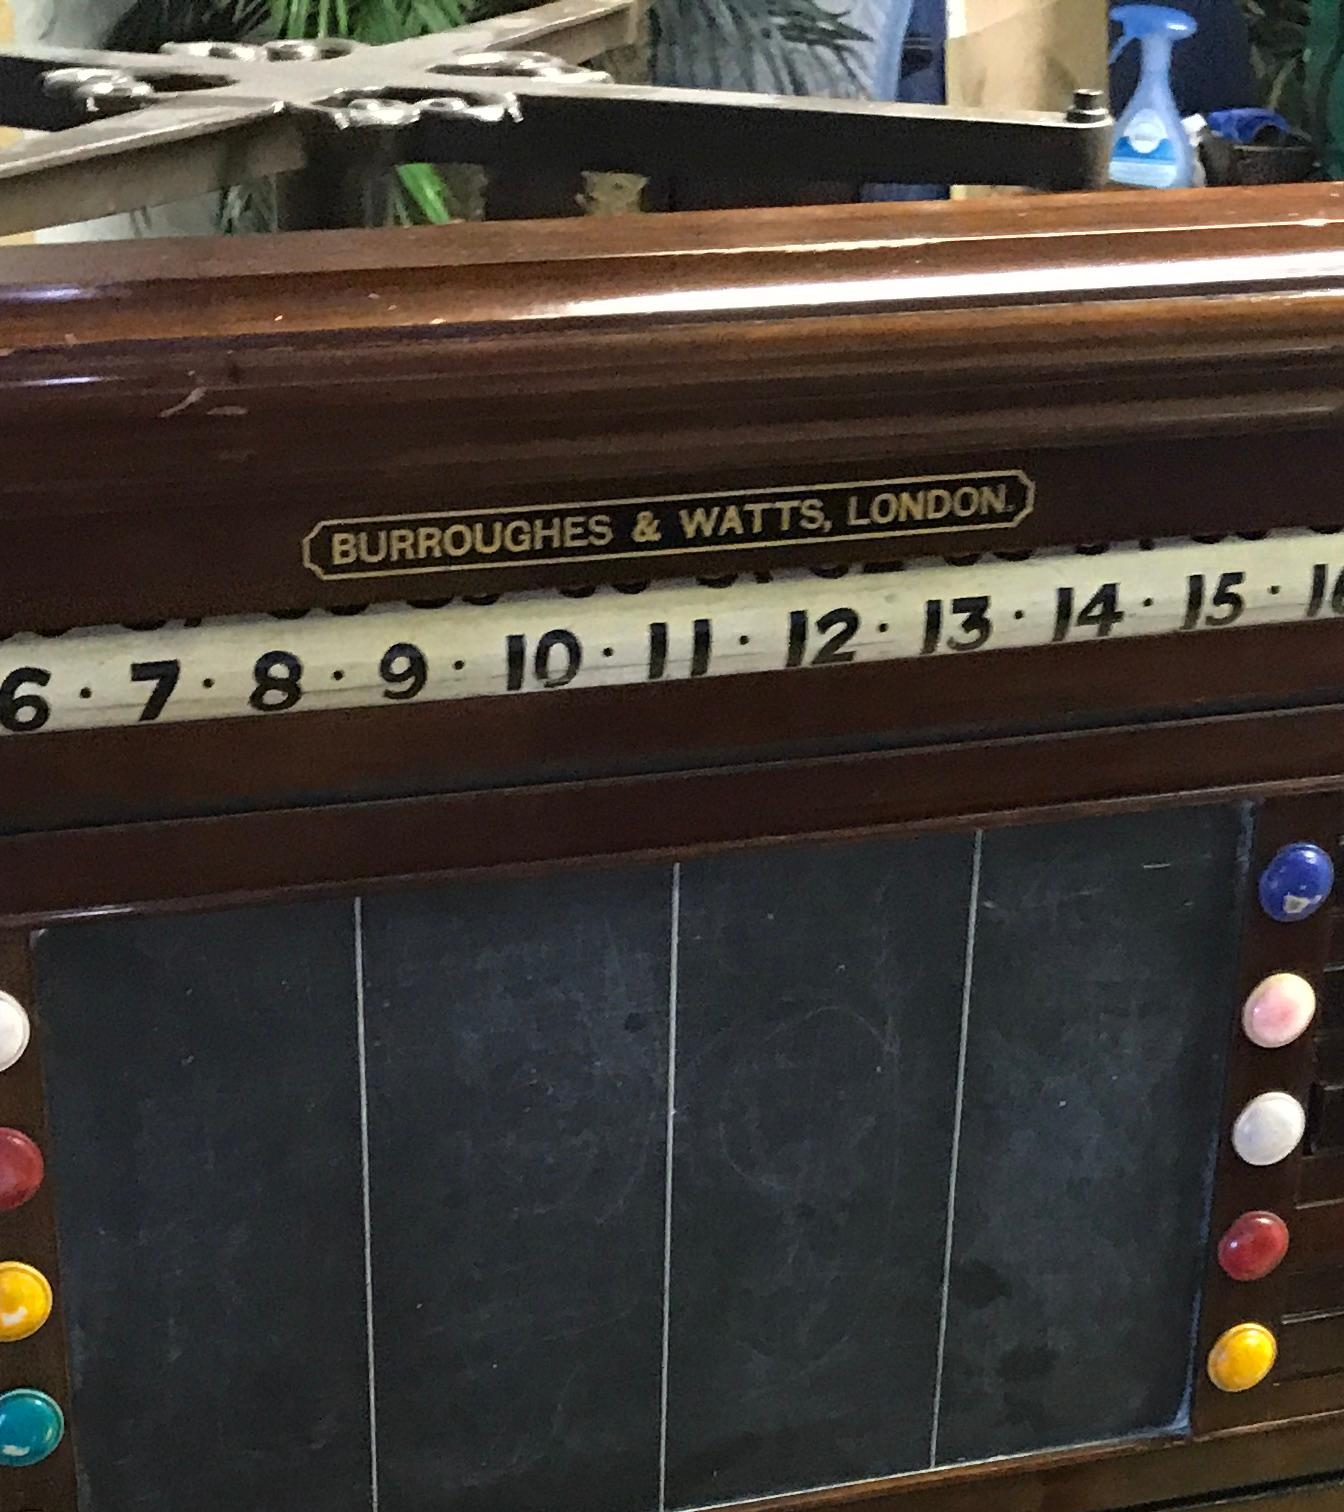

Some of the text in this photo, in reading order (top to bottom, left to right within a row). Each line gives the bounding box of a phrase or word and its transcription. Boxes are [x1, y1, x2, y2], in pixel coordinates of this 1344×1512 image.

[331, 521, 614, 566] BURROUGHES
[632, 510, 663, 544] &
[679, 498, 833, 540] WATTS,
[130, 659, 181, 721] 7
[248, 650, 304, 711] 8
[379, 642, 428, 700] 9
[505, 628, 584, 691] 10
[647, 618, 712, 680] 11
[785, 607, 862, 668] 12
[920, 595, 992, 655] 13
[1052, 582, 1125, 642] 14
[1179, 571, 1247, 631] 15
